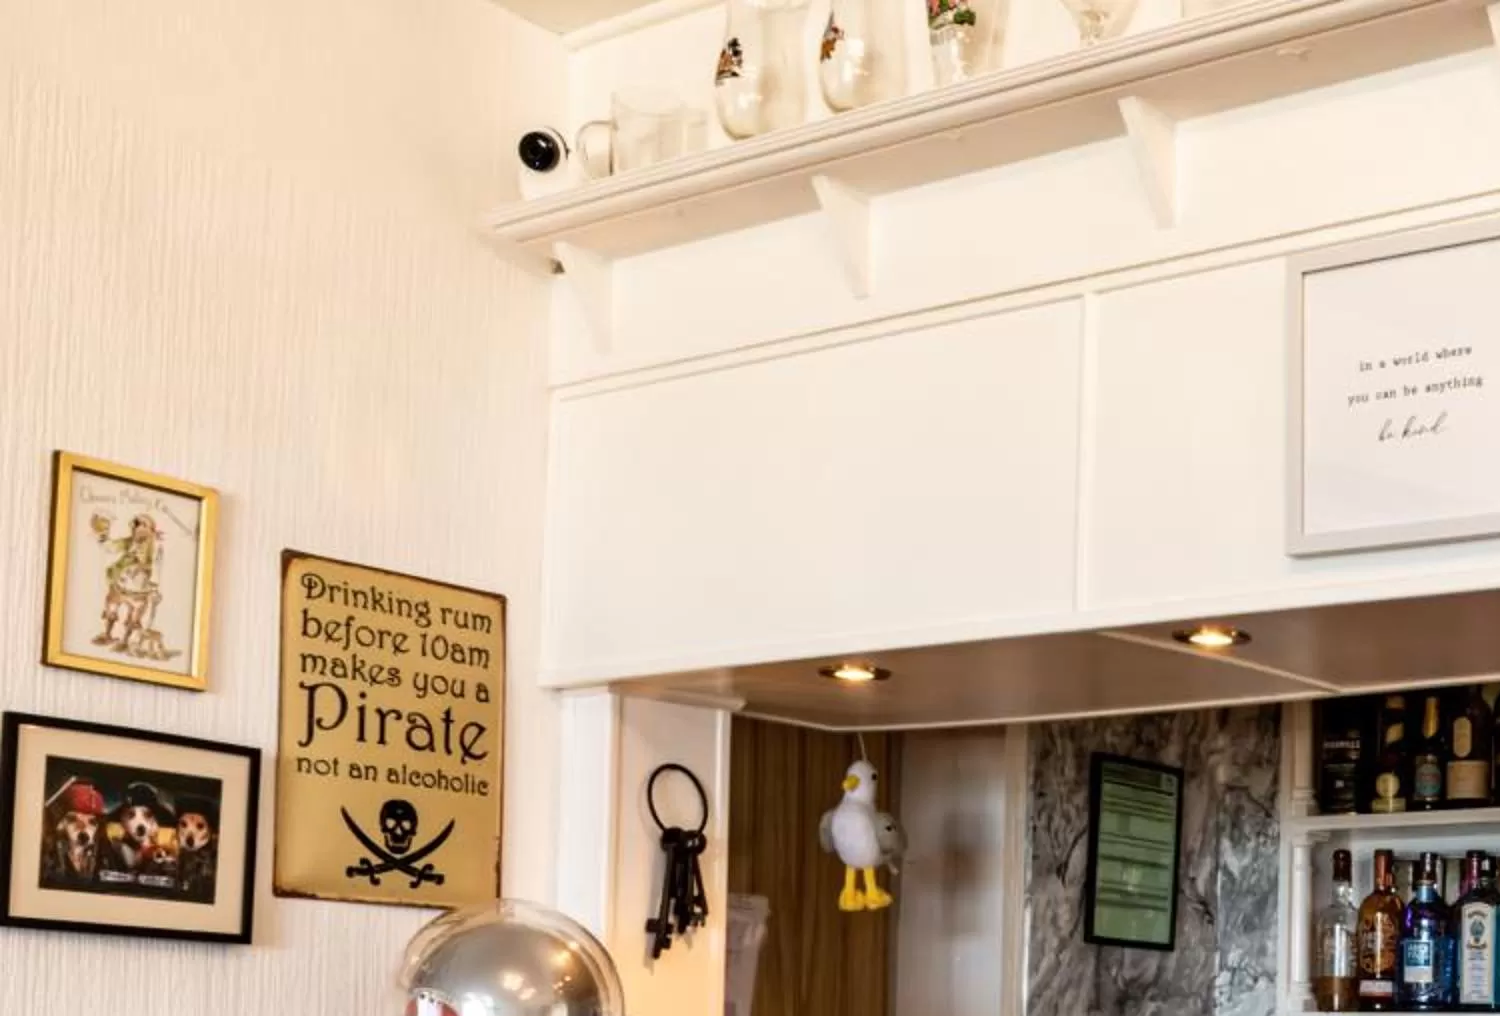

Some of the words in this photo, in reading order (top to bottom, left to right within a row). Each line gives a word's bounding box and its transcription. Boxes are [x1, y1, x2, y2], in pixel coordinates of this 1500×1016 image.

[1359, 361, 1373, 372] in
[1379, 360, 1387, 369] a
[1393, 351, 1429, 366] world
[1435, 346, 1472, 359] where
[1347, 394, 1369, 407] you
[1375, 389, 1397, 400] can
[1403, 384, 1418, 396] be
[1425, 376, 1484, 394] anything
[300, 573, 432, 628] Drinking
[439, 606, 492, 634] rum
[300, 608, 410, 655] before
[420, 633, 491, 669] 10am
[300, 652, 402, 687] makes
[413, 671, 466, 699] you
[475, 682, 491, 703] a
[298, 681, 489, 765] Pirate
[296, 753, 340, 777] not
[348, 761, 378, 783] an
[387, 765, 489, 797] alcoholic
